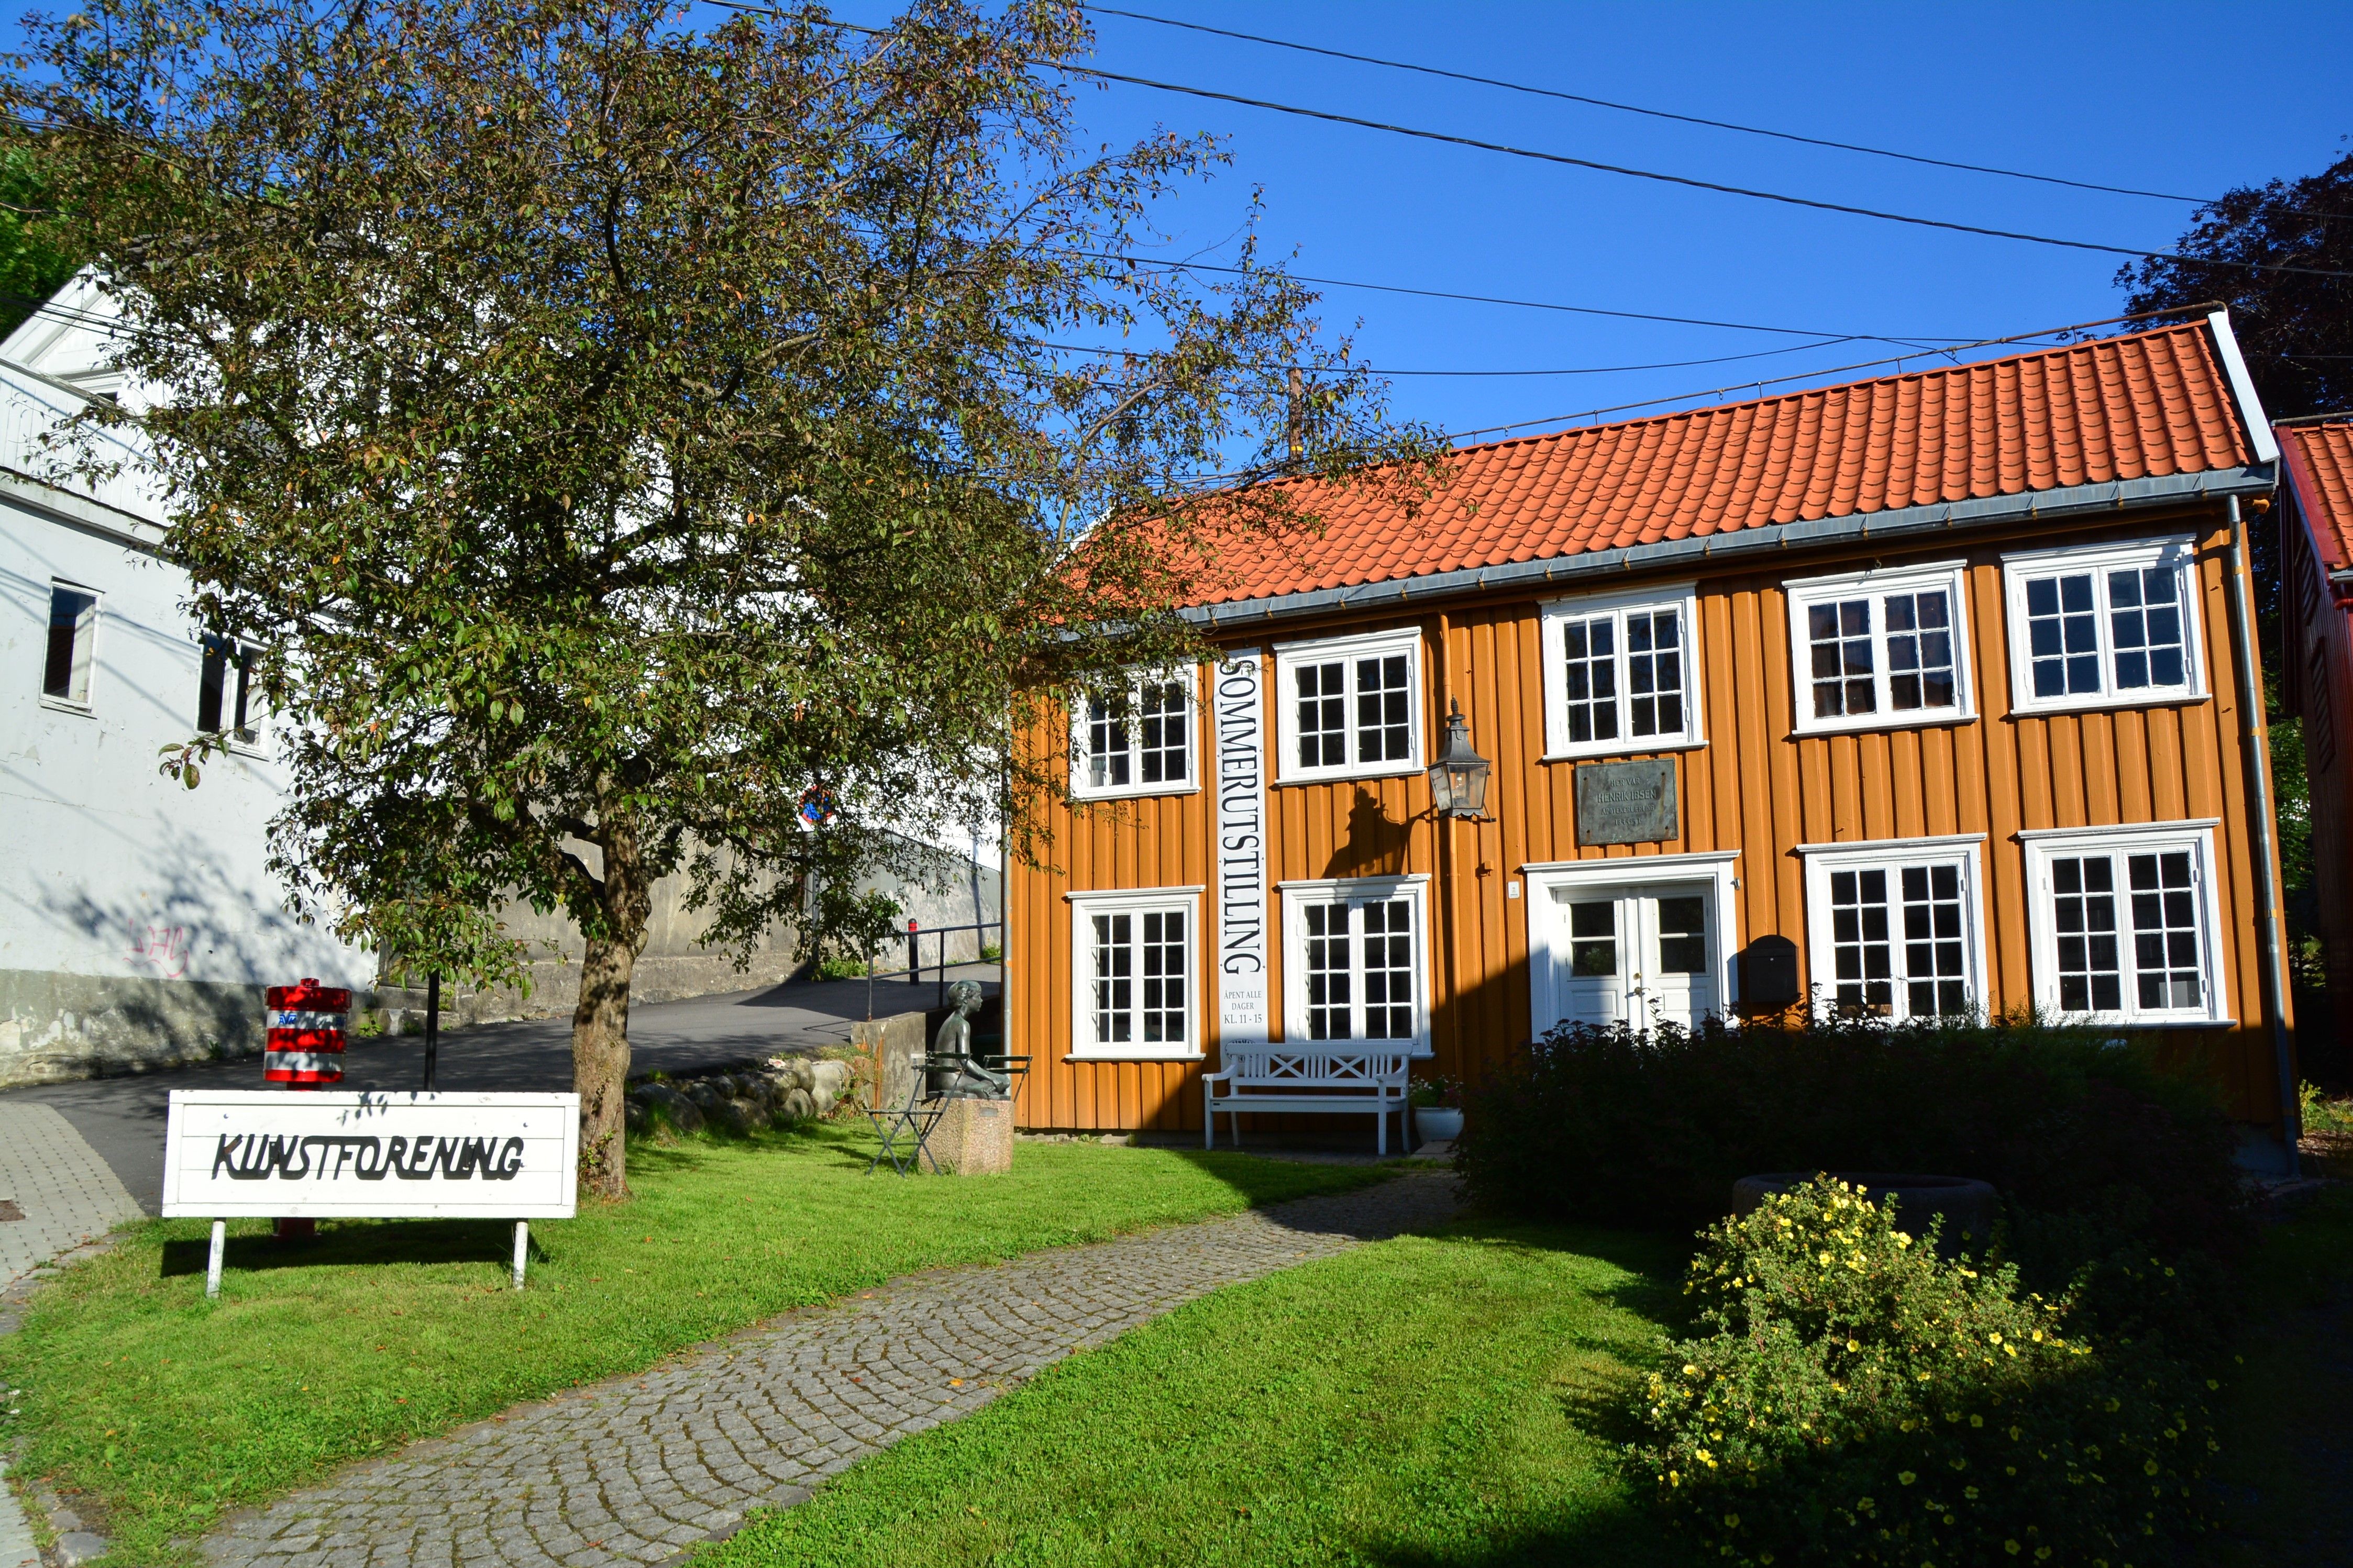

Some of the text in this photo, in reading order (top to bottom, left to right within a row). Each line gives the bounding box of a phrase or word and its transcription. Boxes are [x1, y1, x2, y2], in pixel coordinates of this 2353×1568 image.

[1597, 789, 1656, 803] HENRIK IBSEN
[1219, 660, 1261, 975] SOMMERUTSTILLING
[1224, 990, 1244, 999] ÅPENT
[1224, 1015, 1237, 1024] KL.
[1239, 1015, 1246, 1024] 11
[1255, 1014, 1262, 1023] 15
[211, 1133, 524, 1181] KUNSTFORENING
